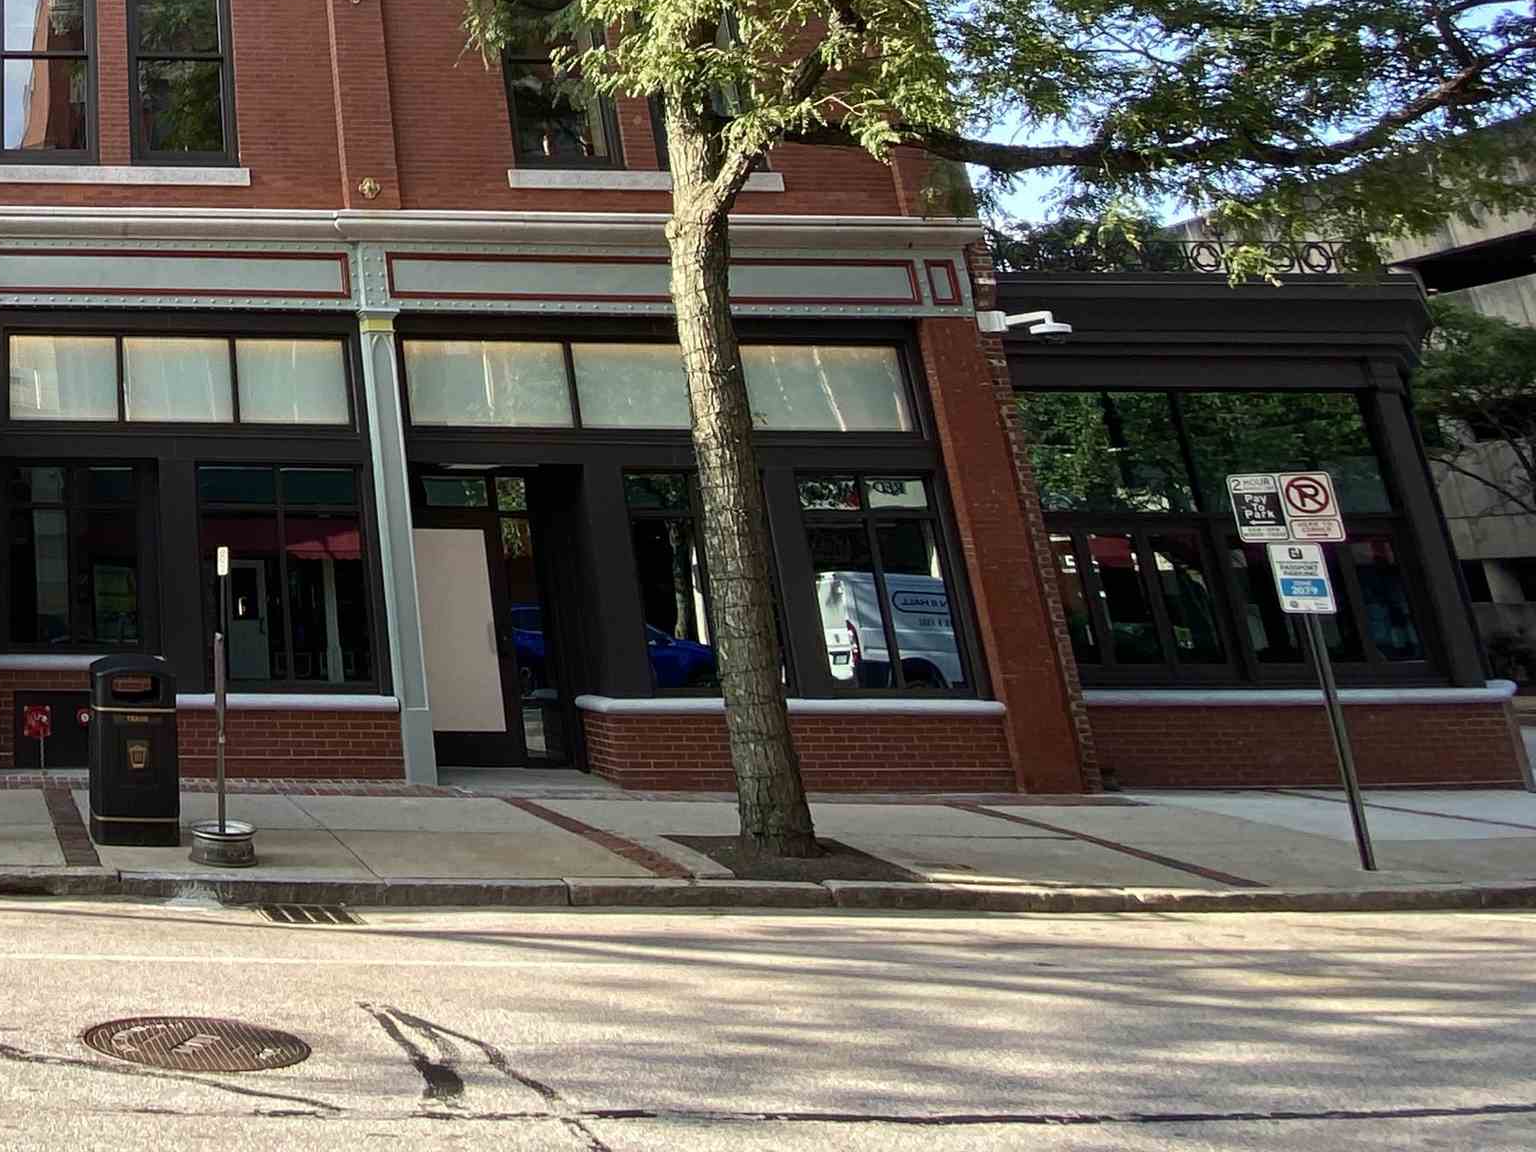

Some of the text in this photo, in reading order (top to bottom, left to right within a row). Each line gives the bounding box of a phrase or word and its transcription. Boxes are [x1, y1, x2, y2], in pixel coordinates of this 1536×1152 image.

[1231, 479, 1242, 491] 2
[1244, 494, 1267, 505] Pay
[1253, 503, 1265, 511] To
[1245, 509, 1276, 519] Park
